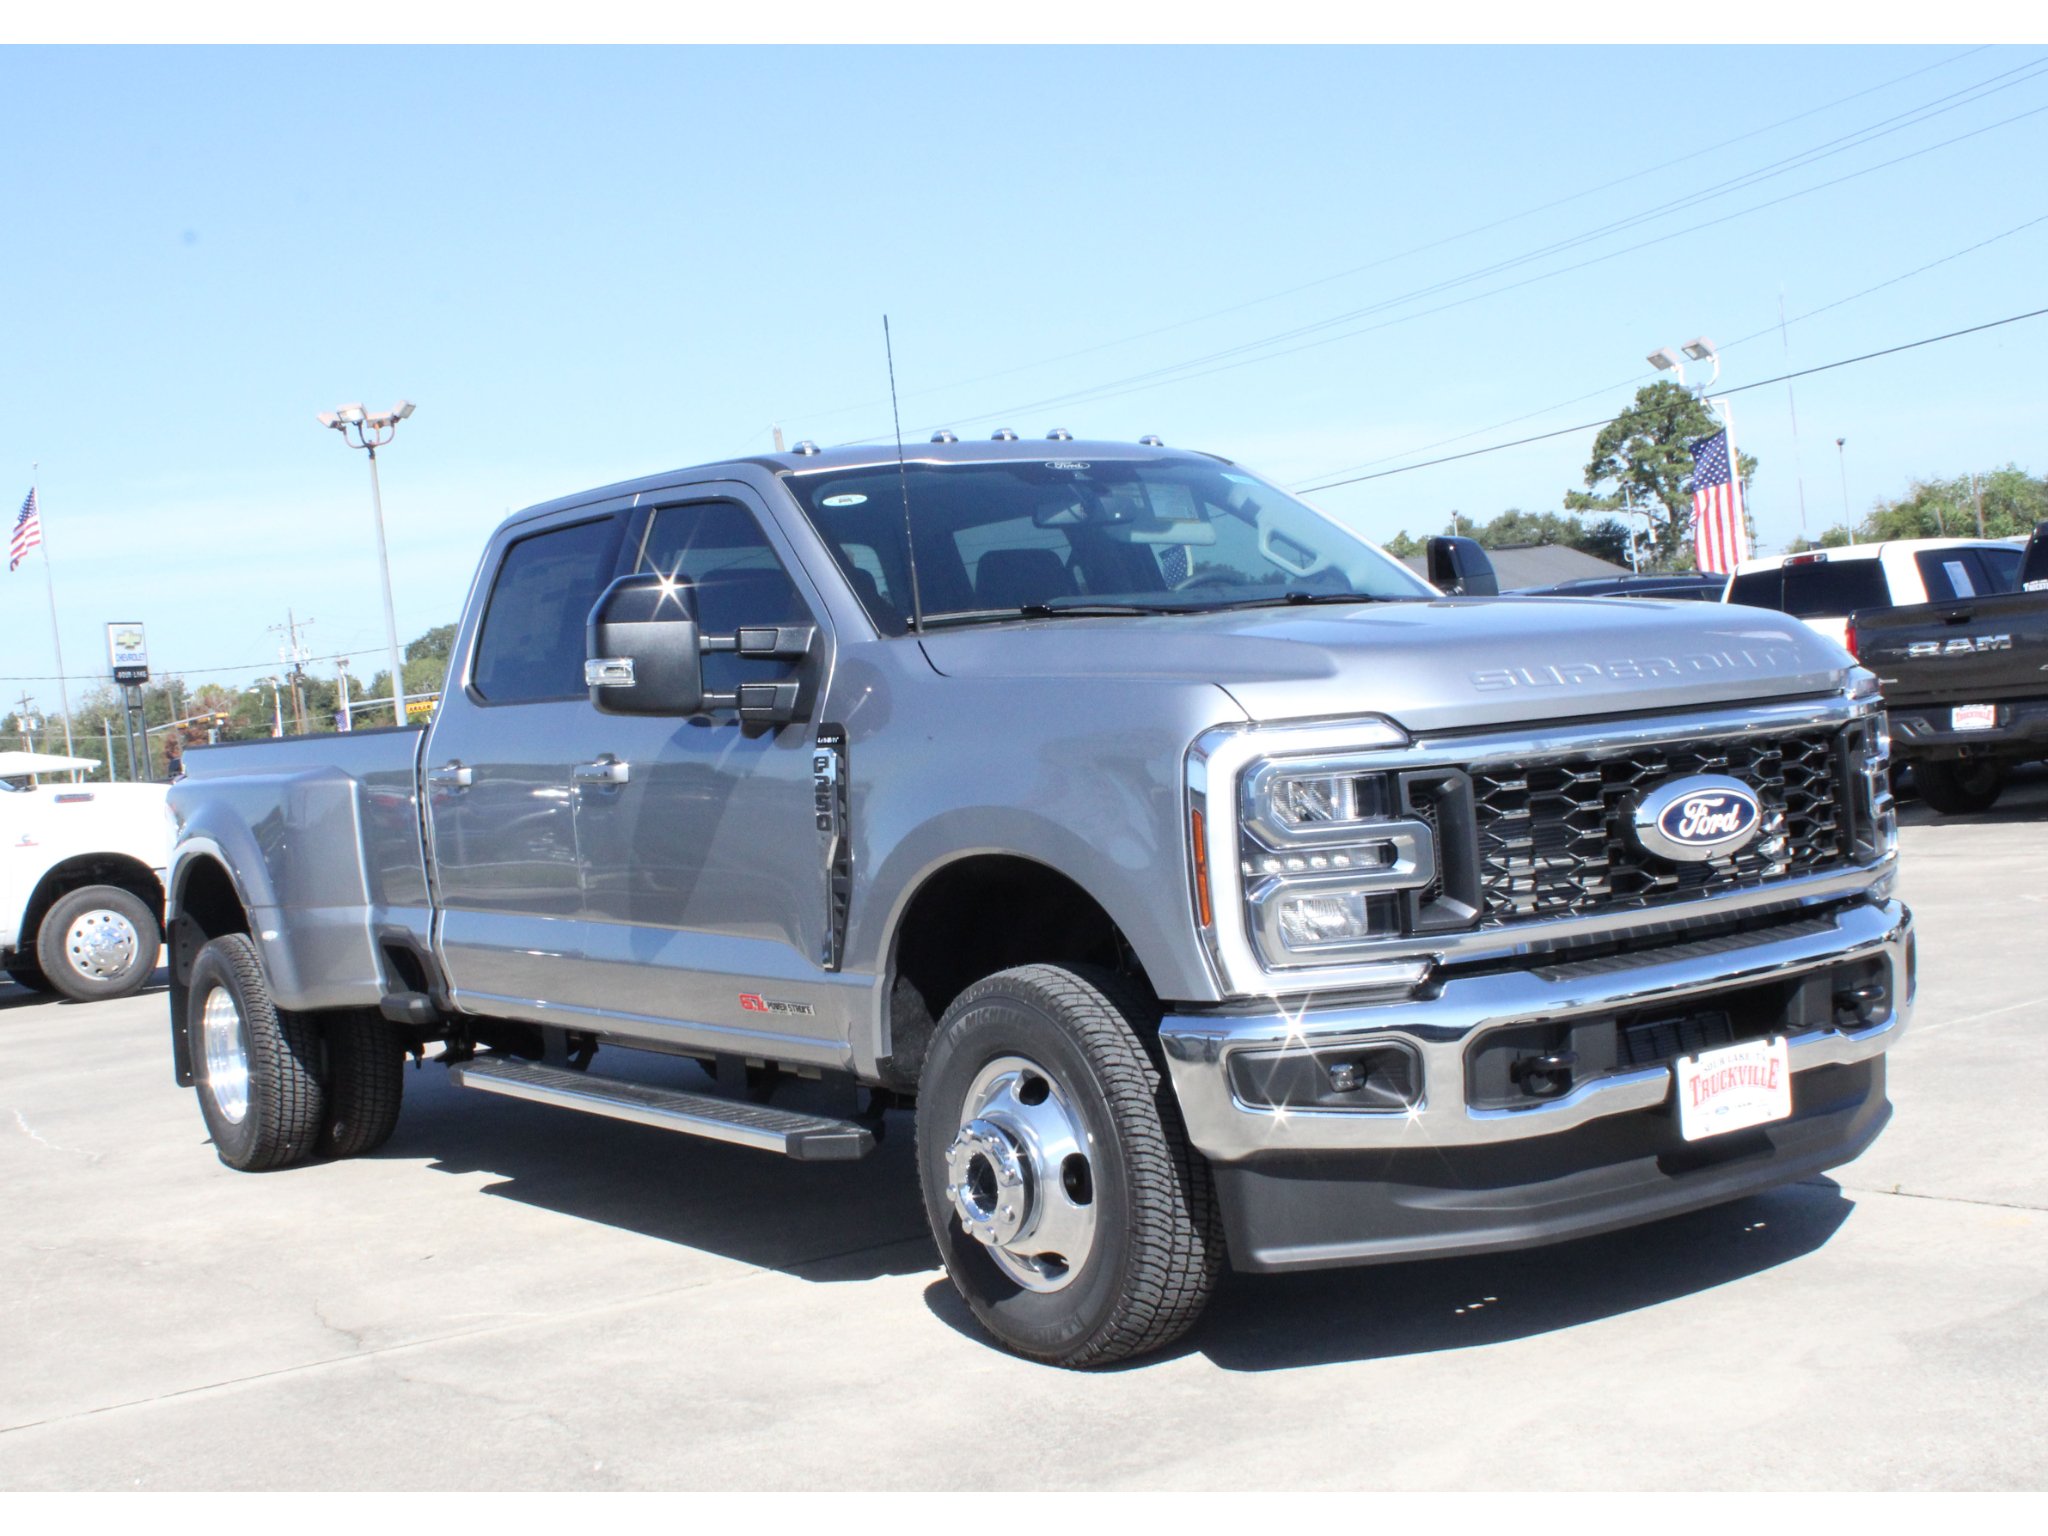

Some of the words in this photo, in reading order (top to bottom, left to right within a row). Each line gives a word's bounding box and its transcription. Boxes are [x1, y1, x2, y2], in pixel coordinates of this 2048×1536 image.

[1469, 656, 1681, 692] SUPER
[1690, 644, 1801, 671] DUTY
[1908, 633, 2012, 658] RAM
[1678, 796, 1741, 838] Ford
[1689, 1058, 1780, 1109] TRUCKVILLE
